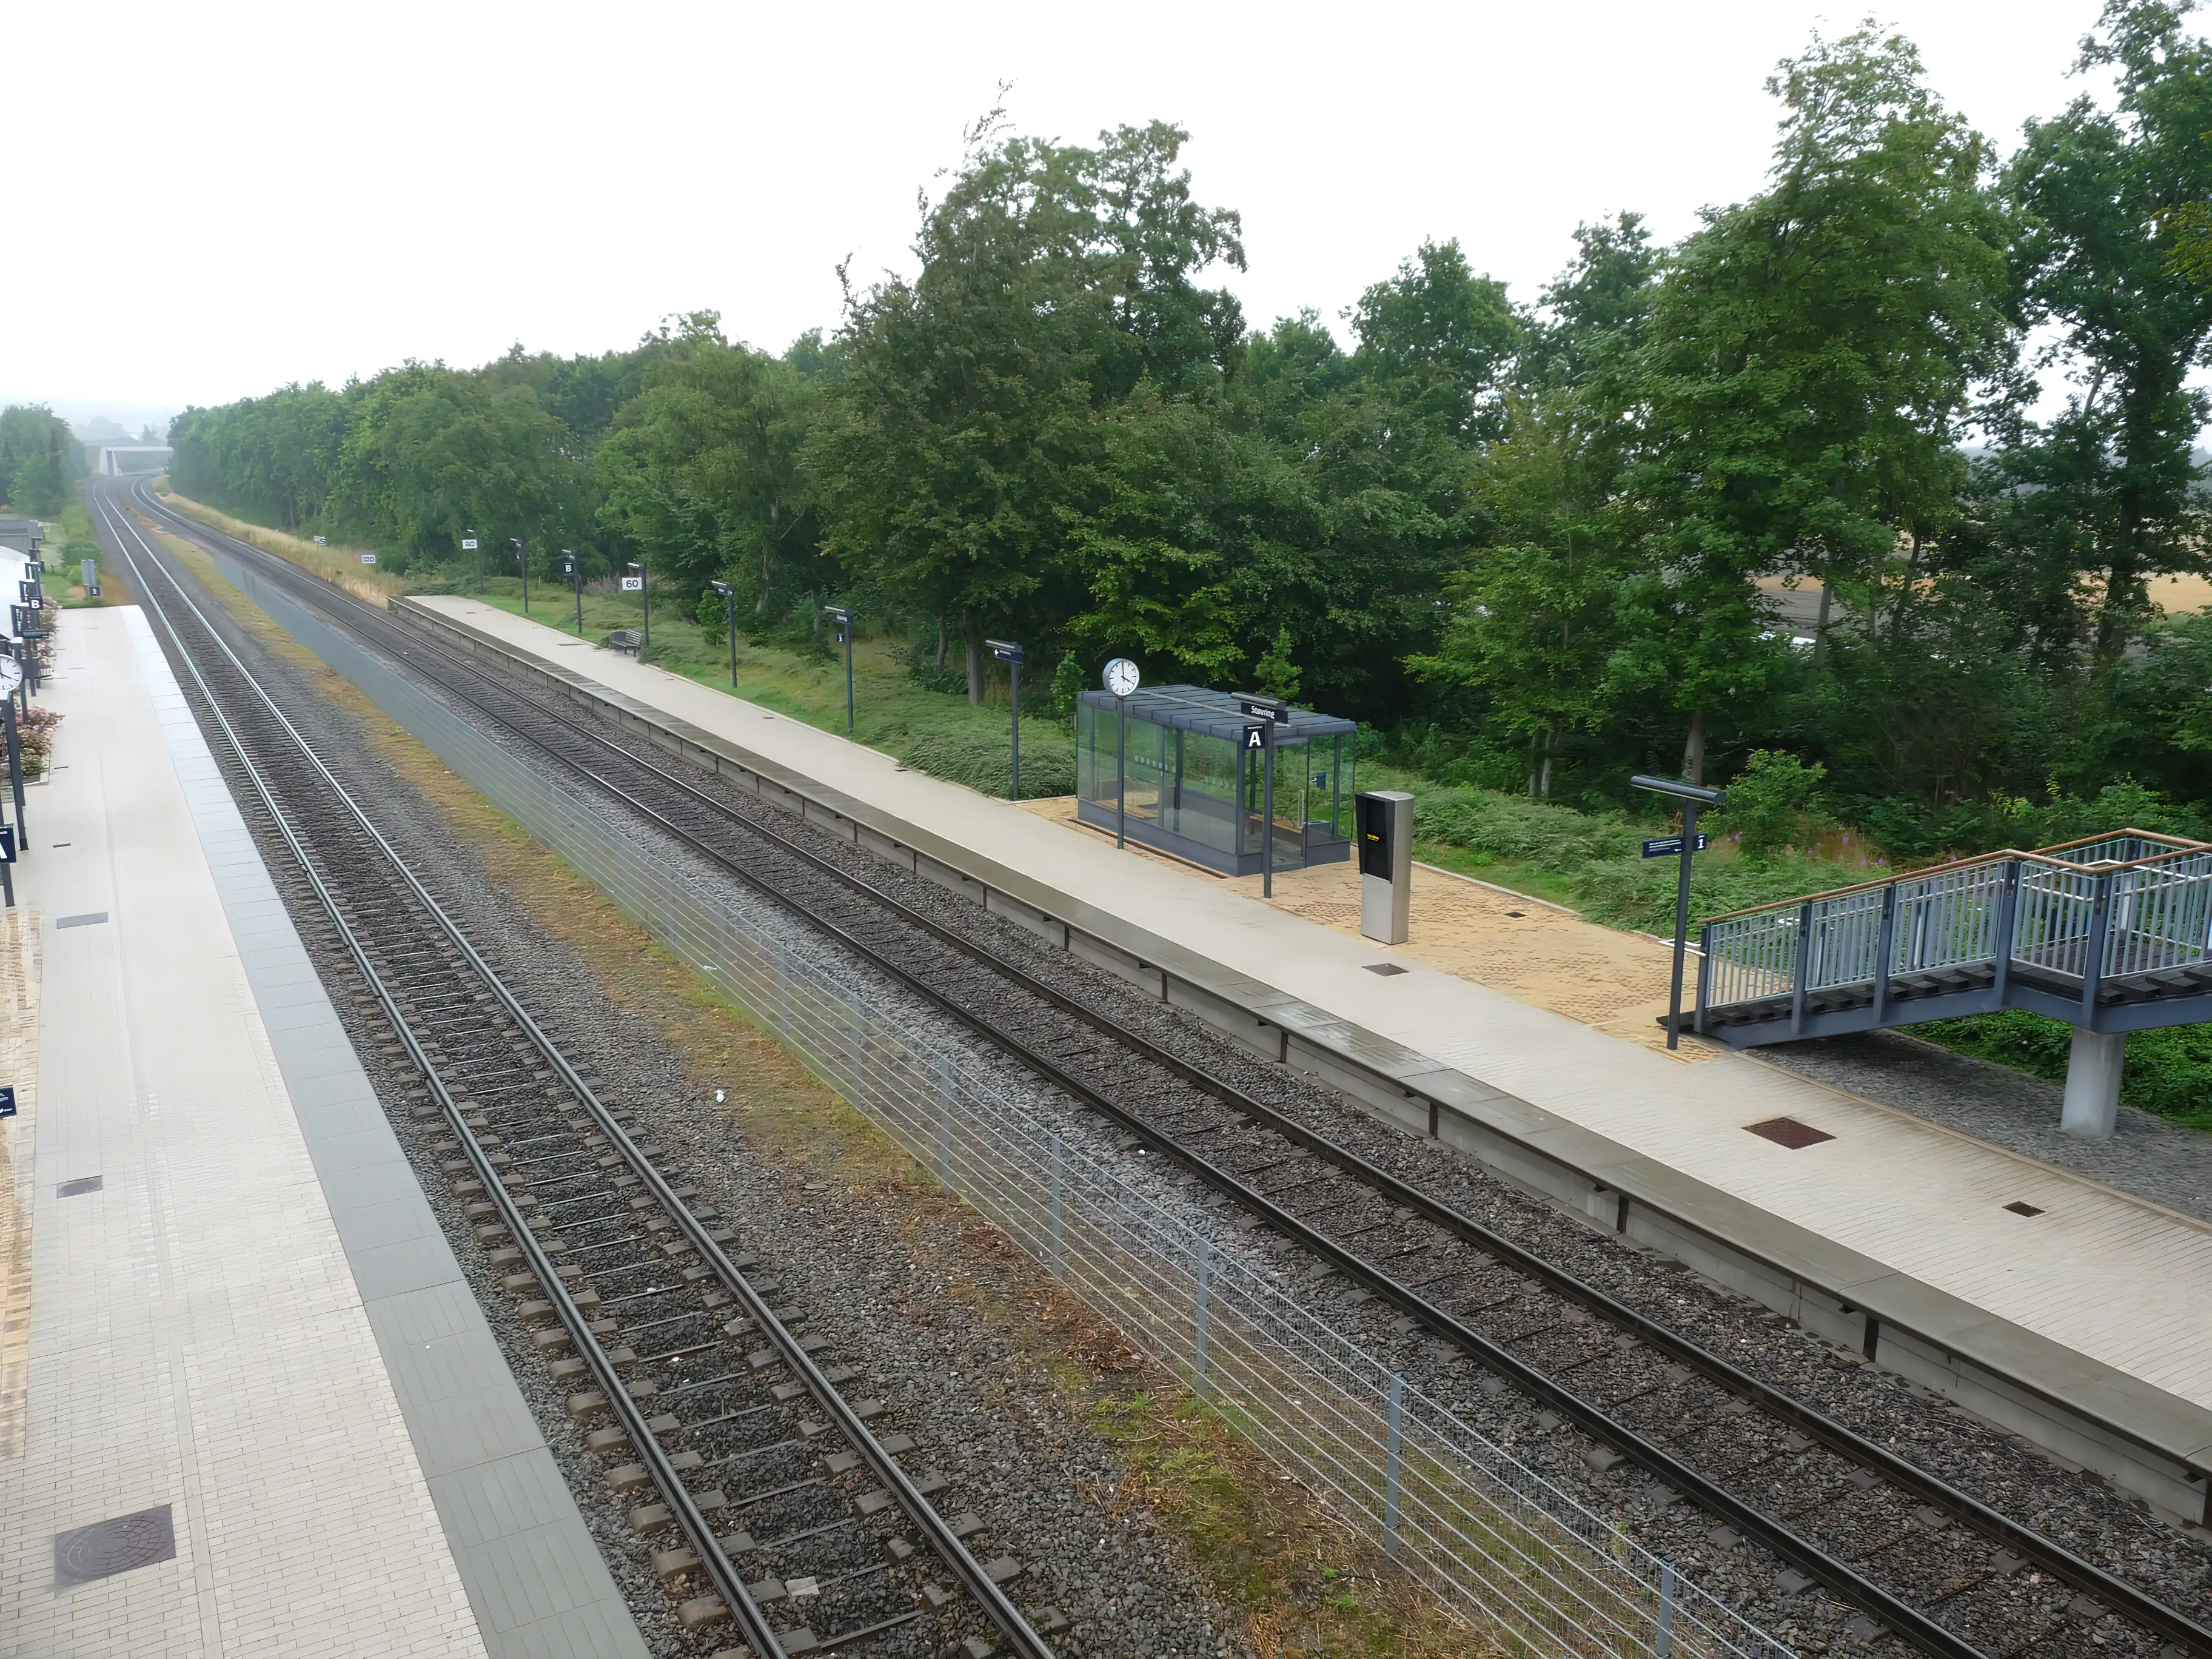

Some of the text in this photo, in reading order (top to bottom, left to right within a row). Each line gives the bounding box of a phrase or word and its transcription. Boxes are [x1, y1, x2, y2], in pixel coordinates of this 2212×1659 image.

[31, 600, 40, 609] B
[1248, 731, 1261, 747] A
[1698, 839, 1704, 849] 1
